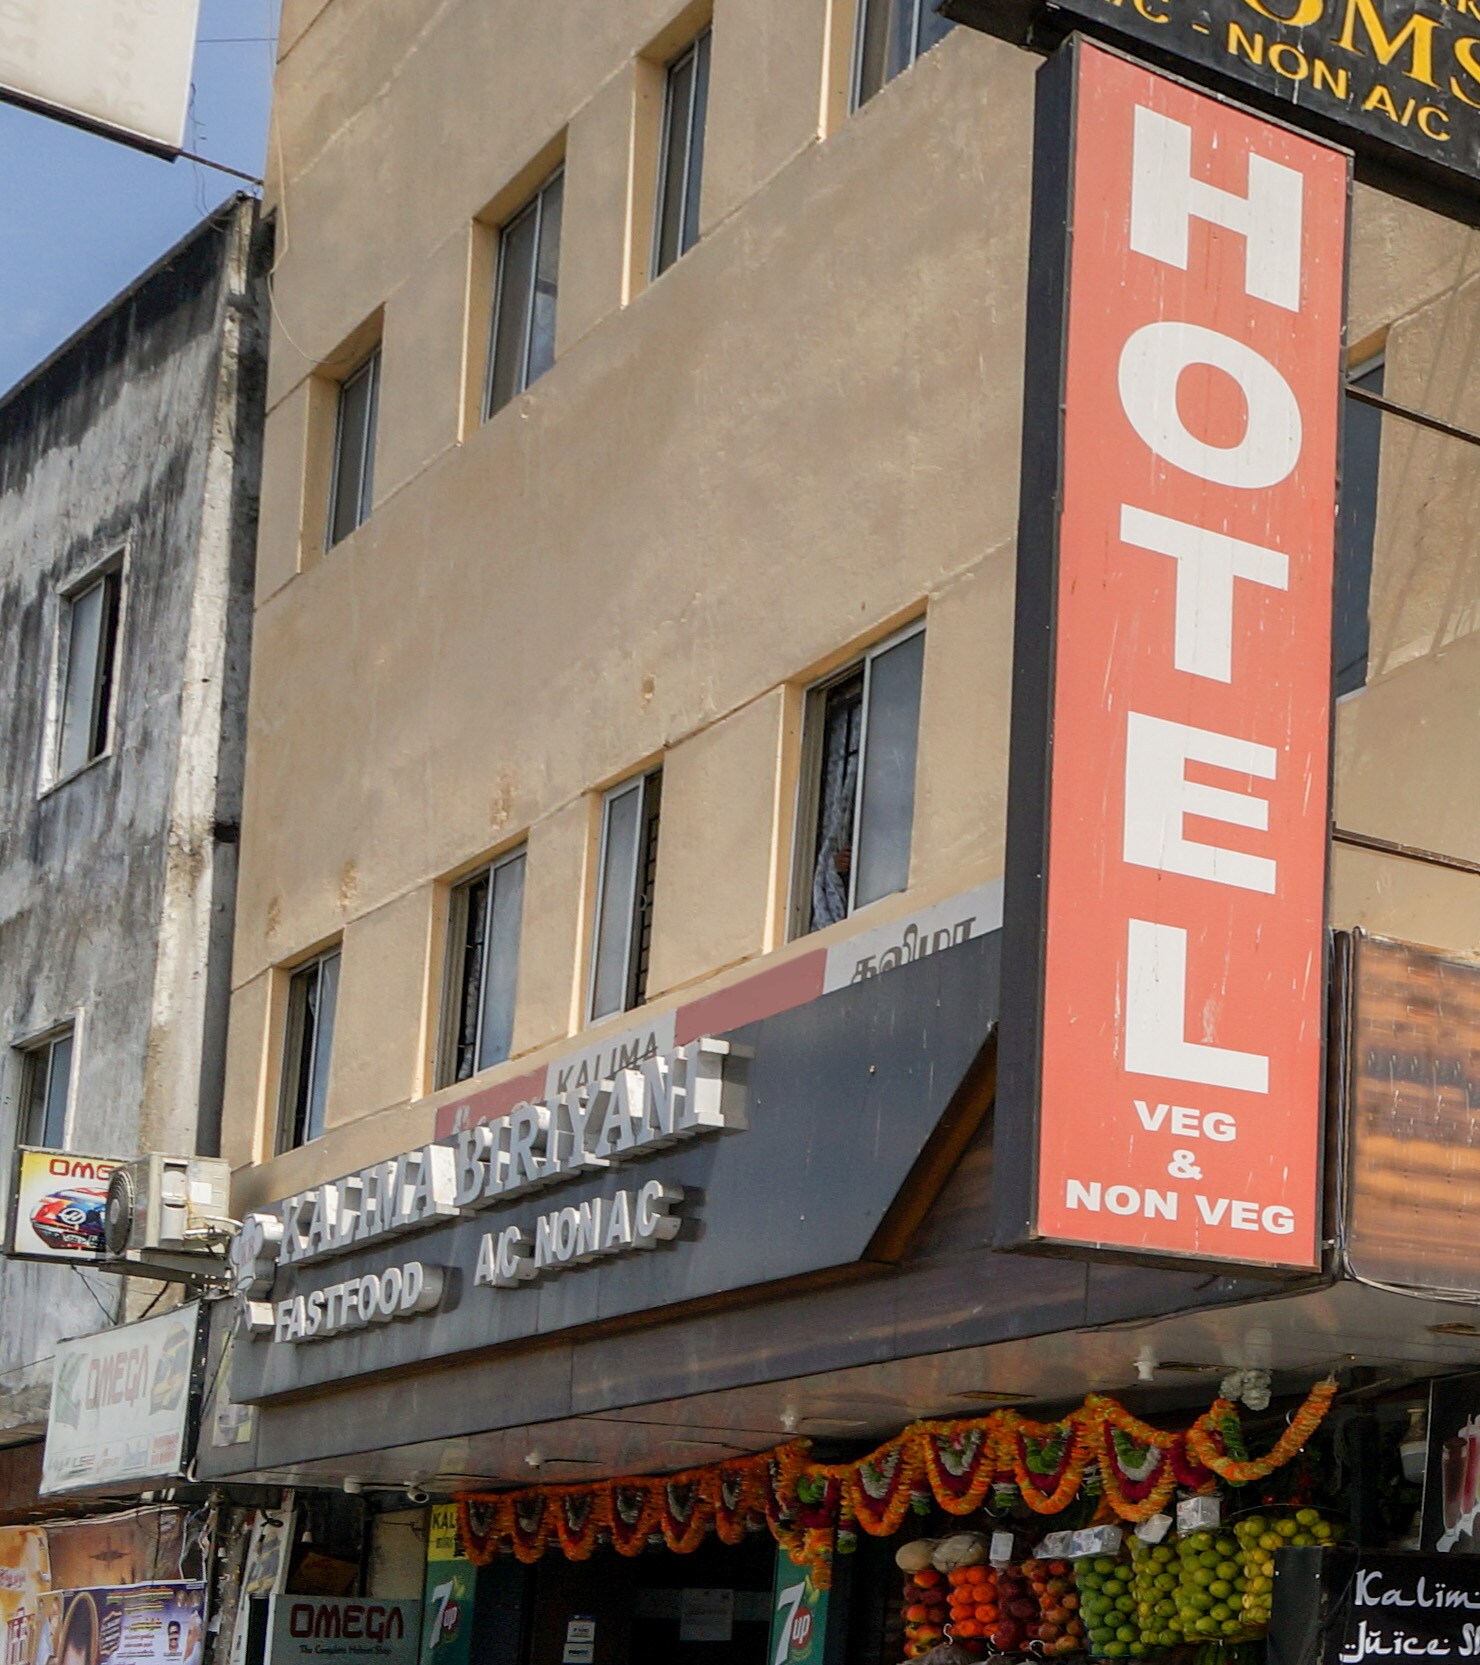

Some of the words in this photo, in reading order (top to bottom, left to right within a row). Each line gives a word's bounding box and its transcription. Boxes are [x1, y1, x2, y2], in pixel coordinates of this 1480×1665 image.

[1226, 22, 1348, 100] NON
[1364, 84, 1452, 143] A/C
[1117, 104, 1303, 1094] HOTEL
[278, 1144, 458, 1266] KALIMA
[454, 1036, 730, 1207] BIRIYANI
[1133, 1100, 1238, 1142] VEG
[1167, 1149, 1203, 1181] &
[1064, 1178, 1179, 1221] NON
[1195, 1195, 1296, 1236] VEG
[274, 1261, 440, 1344] FASTFOOD
[534, 1197, 604, 1269] NON
[85, 1345, 149, 1411] OMEGA
[432, 1511, 457, 1529] KAL
[289, 1603, 405, 1644] OMEGA
